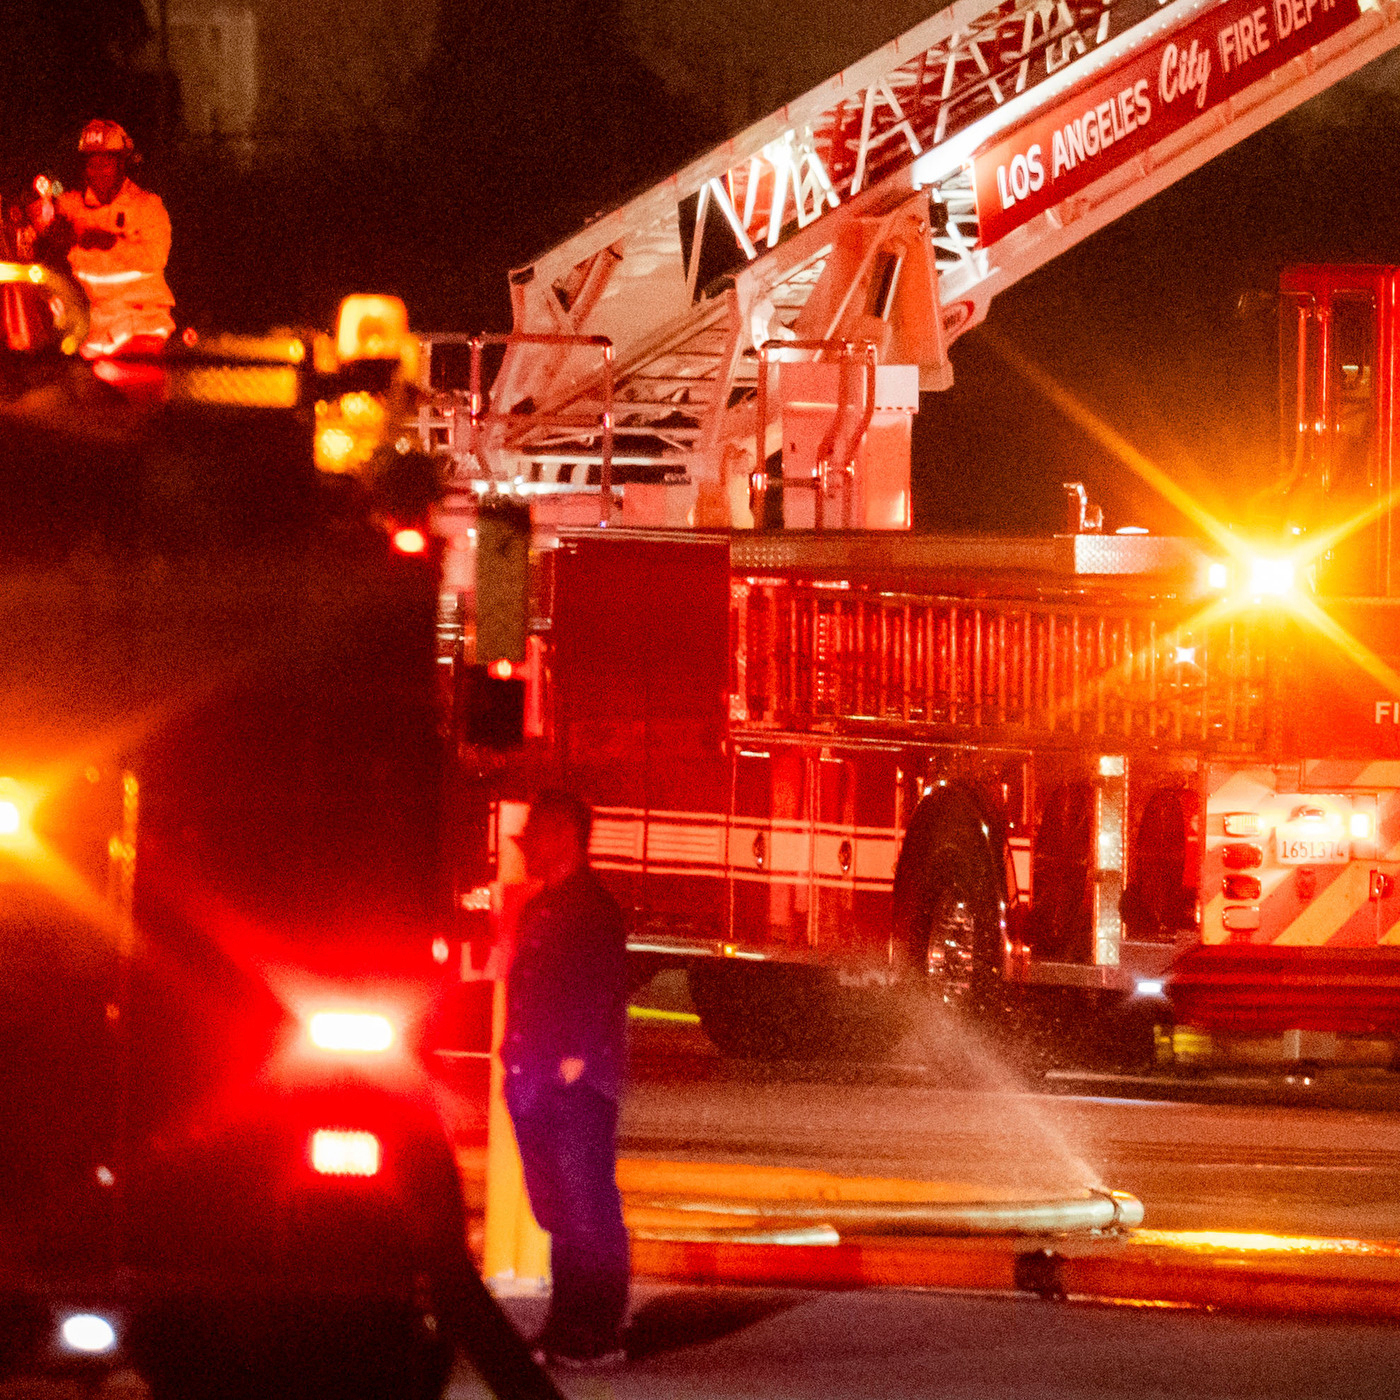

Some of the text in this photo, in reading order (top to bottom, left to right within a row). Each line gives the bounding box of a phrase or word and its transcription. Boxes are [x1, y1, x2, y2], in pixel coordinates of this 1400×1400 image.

[997, 144, 1045, 210] LOS
[1052, 79, 1152, 179] ANGELES
[1159, 40, 1211, 109] City
[1219, 6, 1270, 74] FIRE
